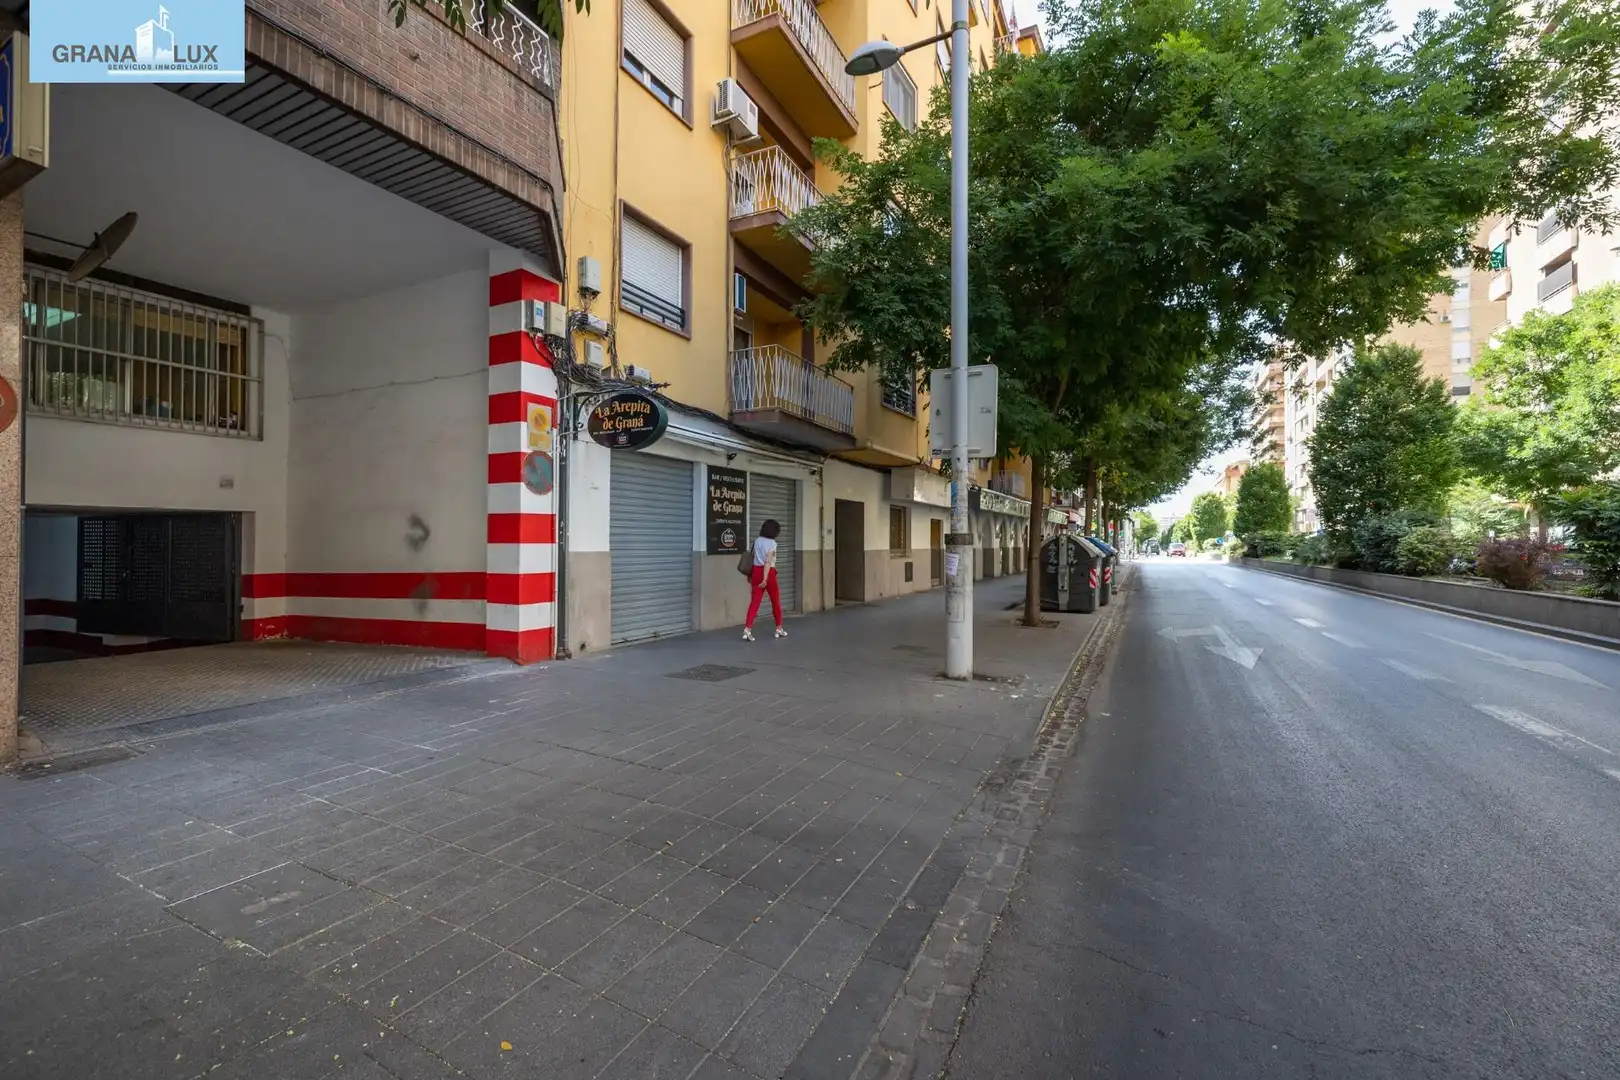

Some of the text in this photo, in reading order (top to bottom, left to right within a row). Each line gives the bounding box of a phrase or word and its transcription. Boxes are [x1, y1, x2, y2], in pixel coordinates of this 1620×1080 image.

[595, 400, 651, 419] La Arepita
[602, 413, 645, 433] de Graná
[709, 485, 721, 498] La
[712, 499, 722, 512] de
